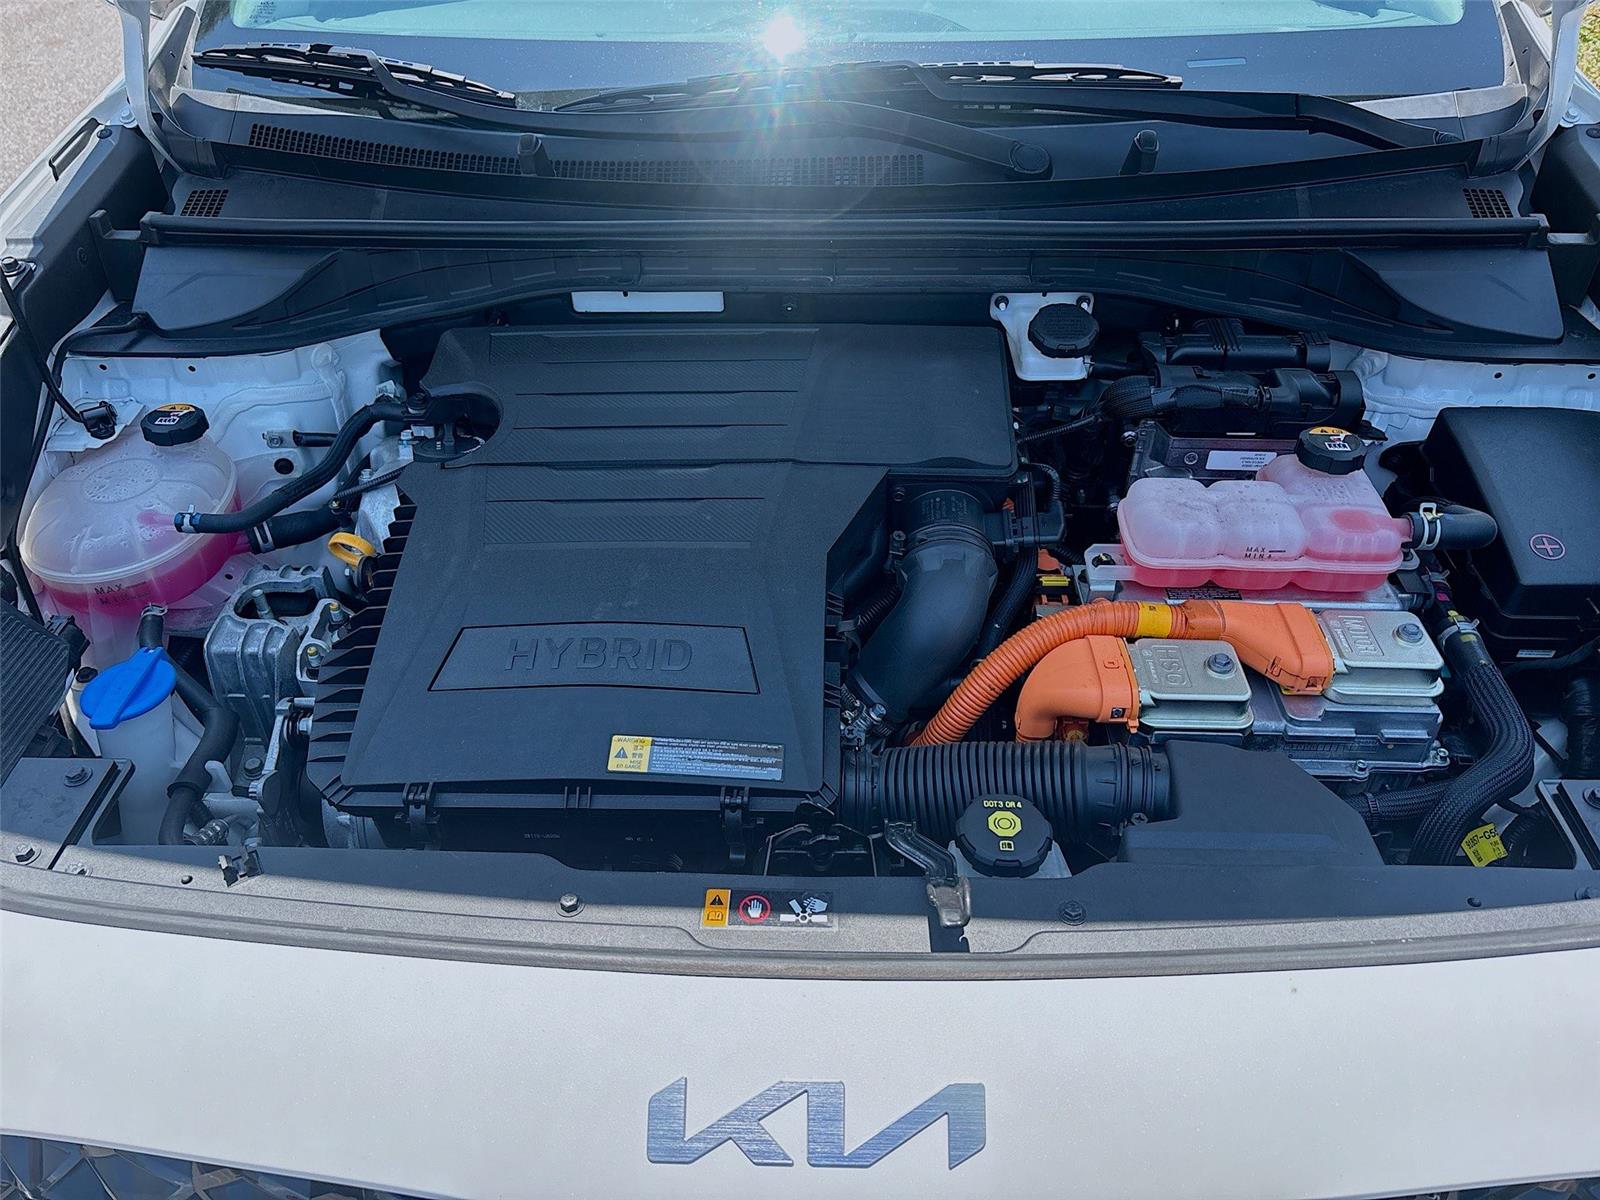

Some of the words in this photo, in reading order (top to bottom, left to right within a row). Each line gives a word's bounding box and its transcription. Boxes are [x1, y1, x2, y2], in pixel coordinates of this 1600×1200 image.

[94, 583, 122, 595] MAX
[504, 637, 693, 672] HYBRID
[1155, 648, 1188, 686] HSG
[983, 800, 1003, 808] DOT3
